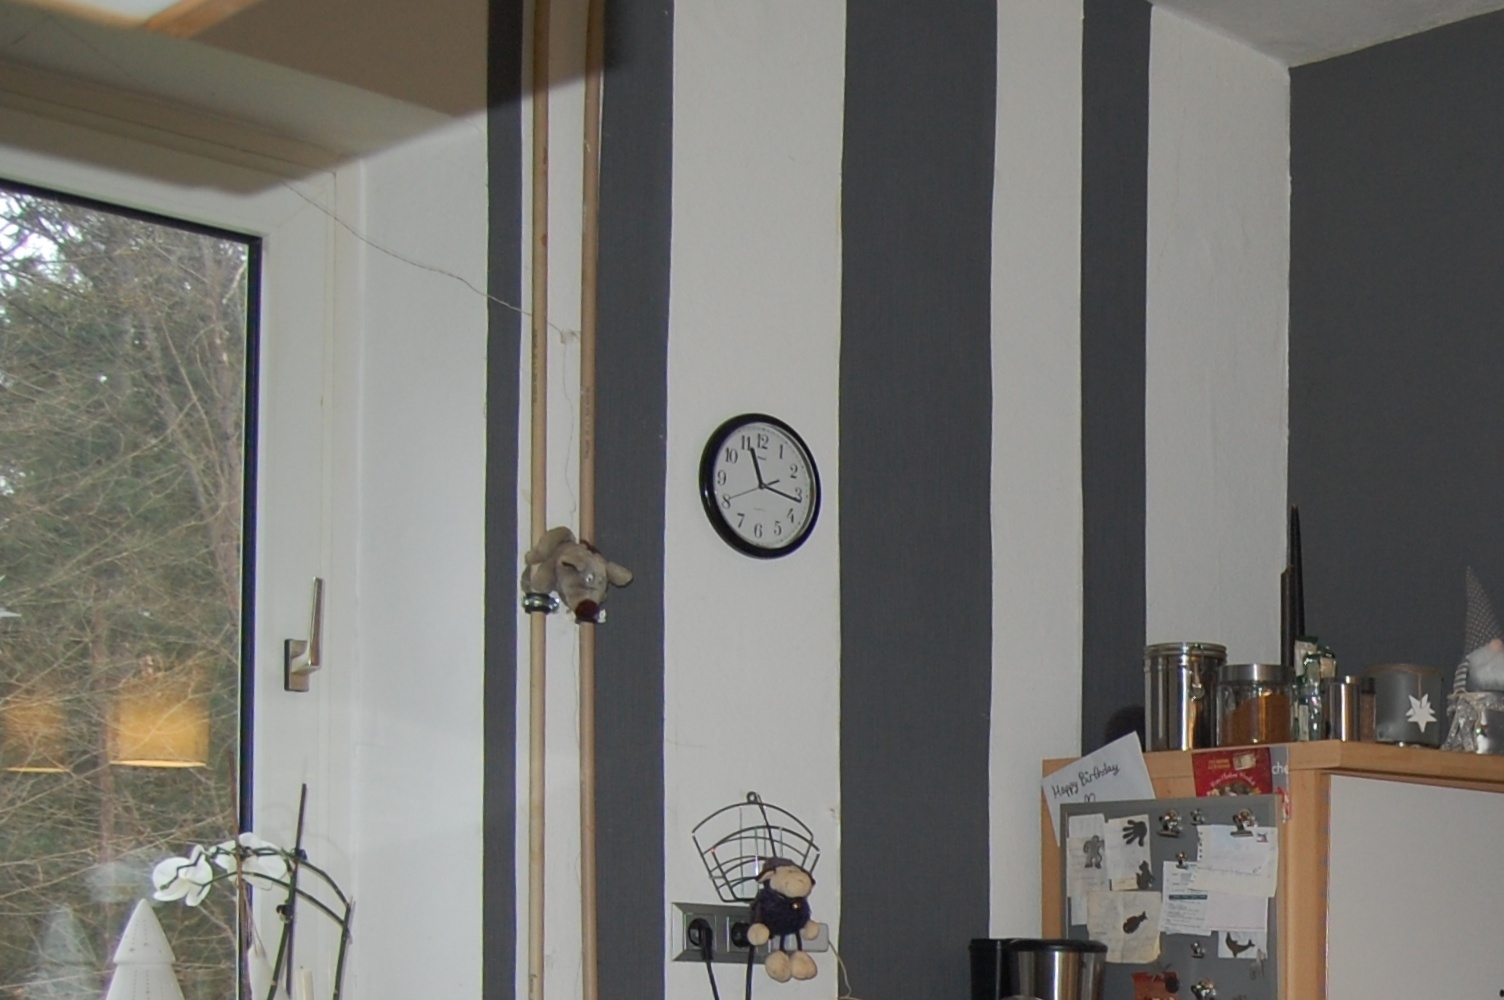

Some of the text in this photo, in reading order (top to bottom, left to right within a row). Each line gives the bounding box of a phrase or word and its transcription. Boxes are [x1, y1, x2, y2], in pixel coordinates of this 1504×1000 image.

[742, 435, 751, 451] 11
[757, 433, 769, 450] 12
[726, 447, 738, 464] 10
[717, 469, 727, 486] 9
[790, 463, 798, 479] 2
[722, 494, 731, 509] 8
[795, 487, 802, 503] 3
[737, 512, 745, 528] 7
[787, 507, 794, 523] 4
[754, 523, 763, 539] 6
[774, 520, 782, 536] 5
[1051, 762, 1120, 799] Happy Birthday
